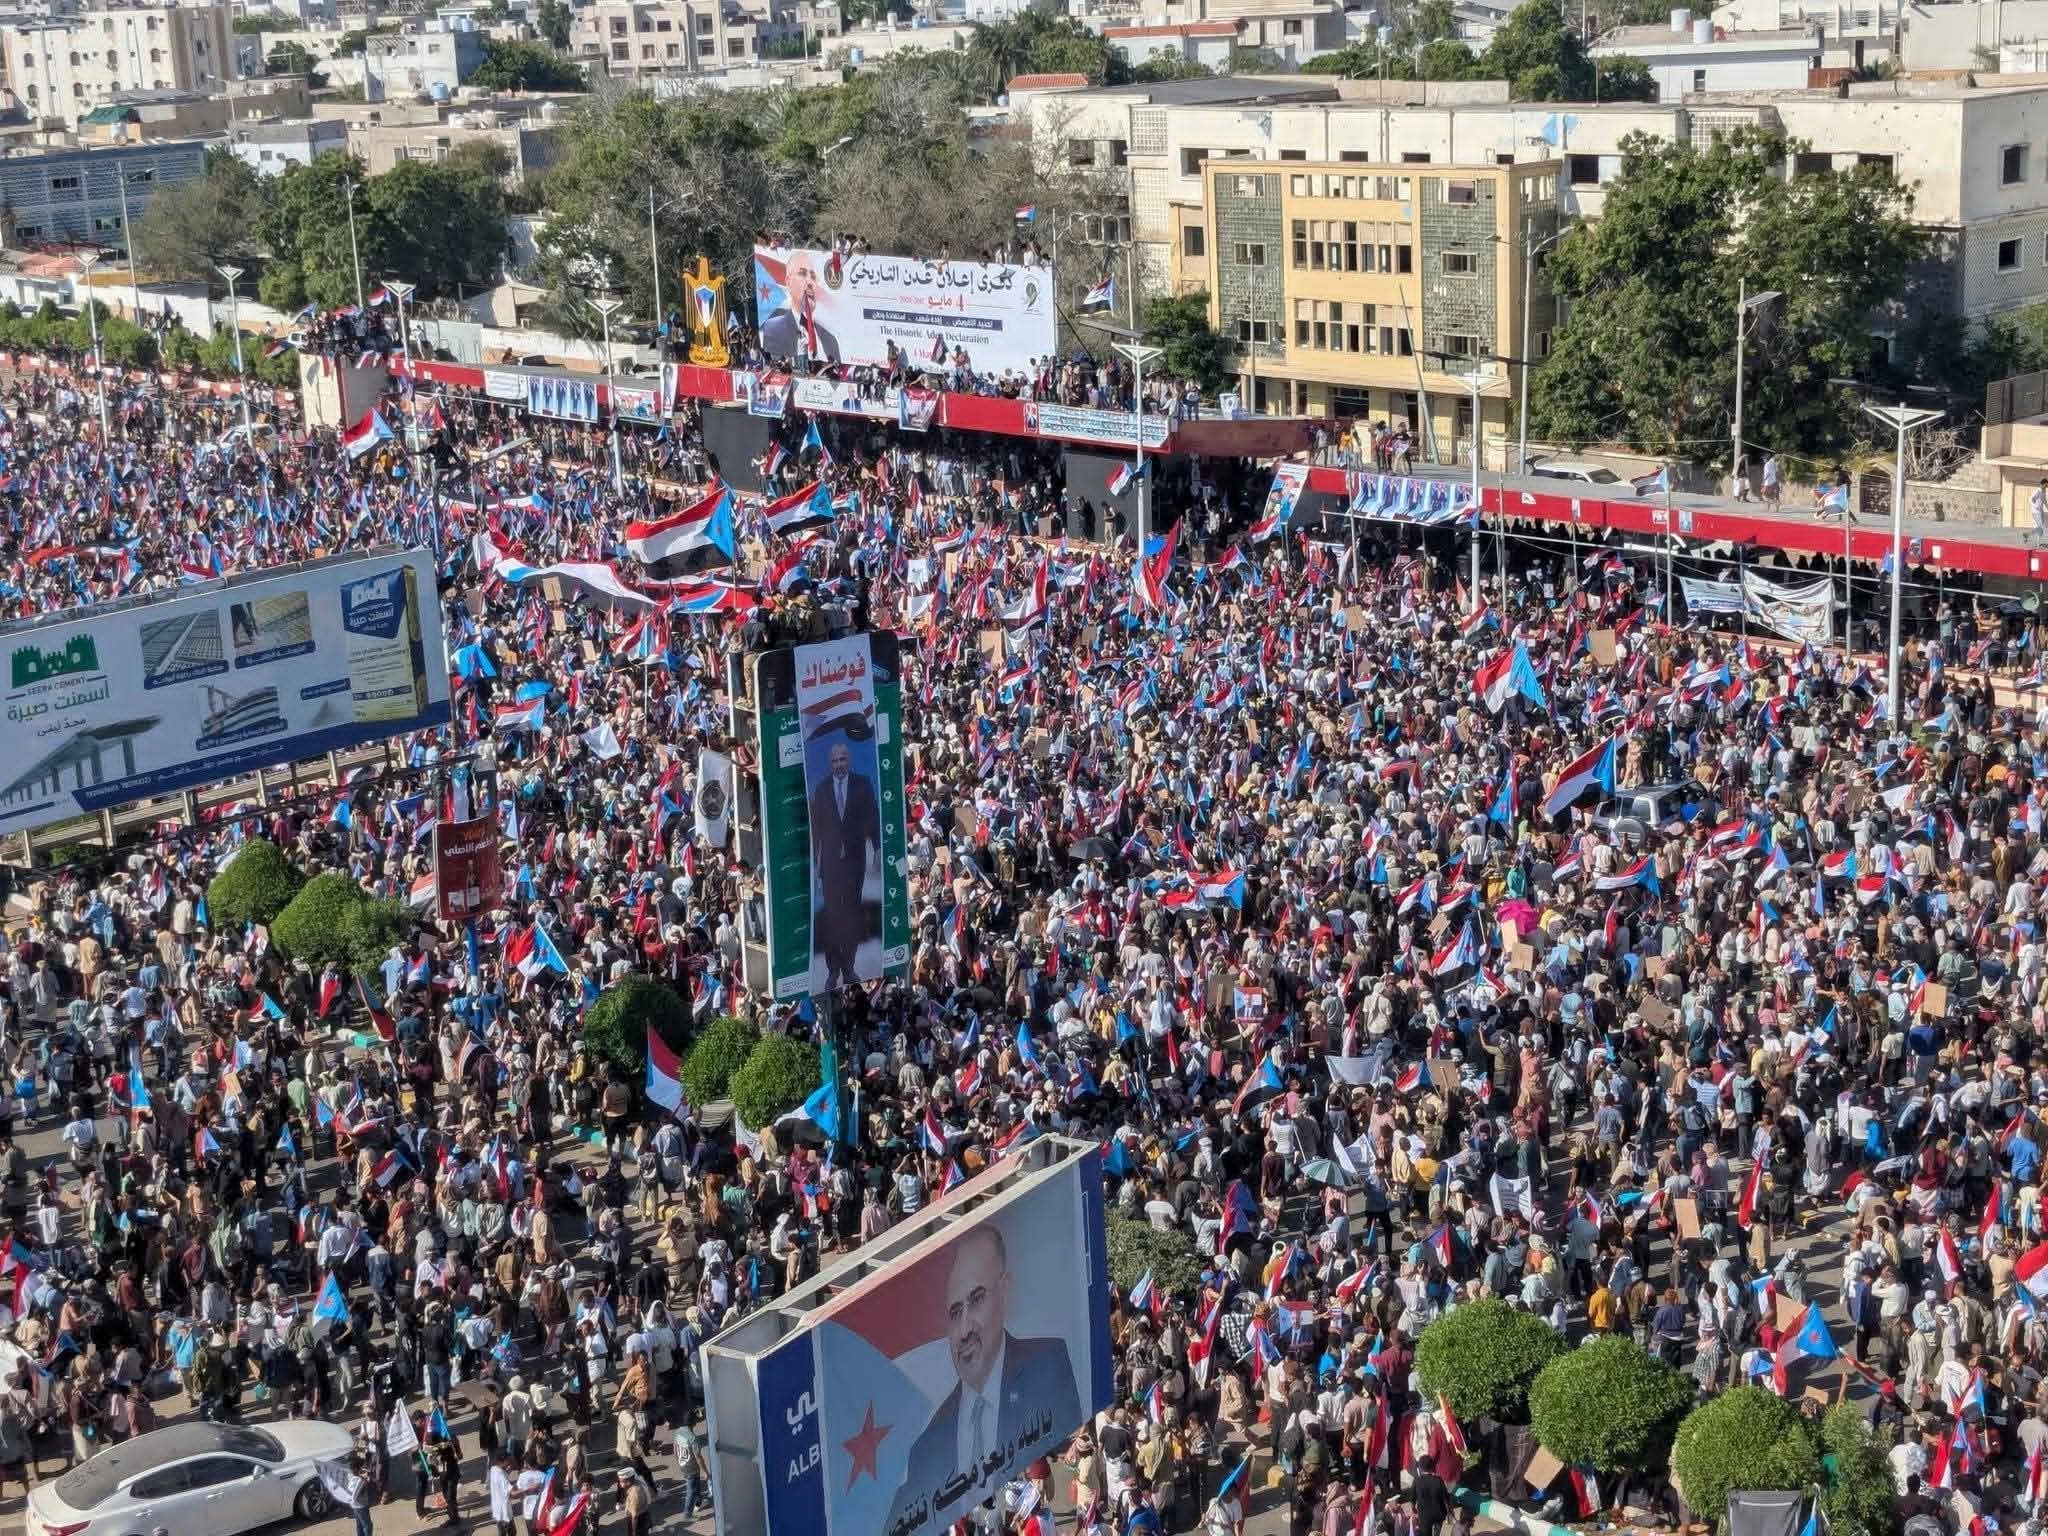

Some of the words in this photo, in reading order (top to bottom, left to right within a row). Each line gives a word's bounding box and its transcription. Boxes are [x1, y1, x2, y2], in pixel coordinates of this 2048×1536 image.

[927, 293, 953, 311] مايو
[880, 325, 893, 336] The
[894, 327, 923, 339] Historic
[945, 331, 989, 345] Declaration
[801, 650, 866, 689] فوضناك
[54, 675, 86, 691] CEMENT
[7, 702, 49, 723] صيرة
